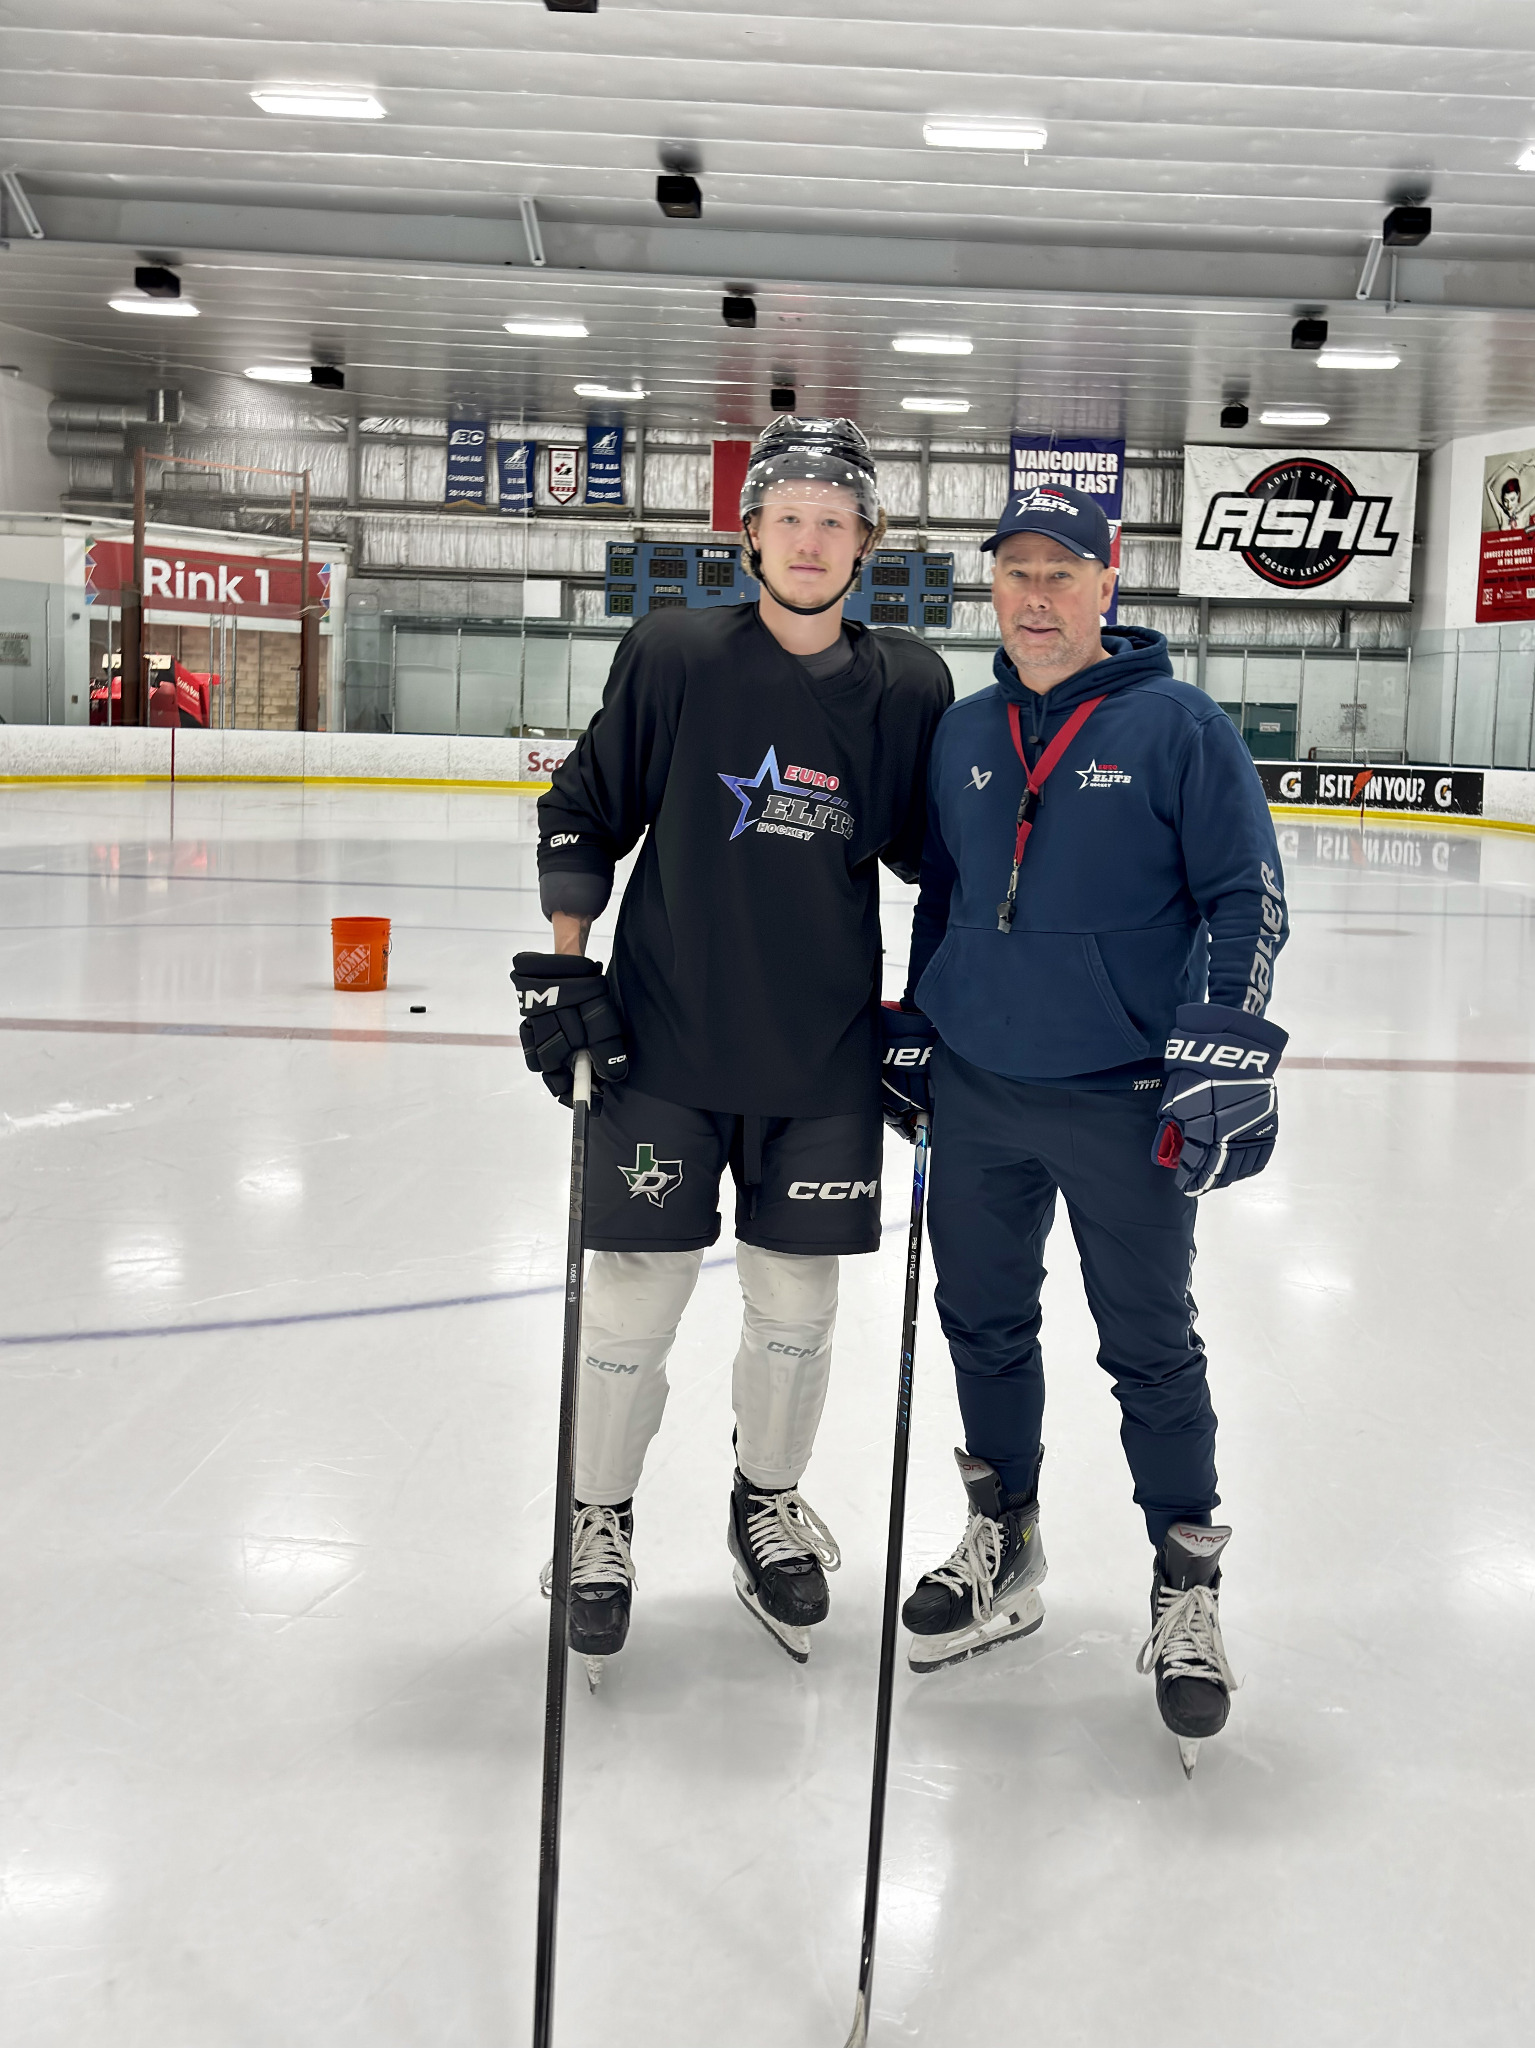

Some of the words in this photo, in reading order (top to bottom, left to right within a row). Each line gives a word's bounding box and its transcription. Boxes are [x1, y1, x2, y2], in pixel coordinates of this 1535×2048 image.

[449, 429, 485, 445] BC
[787, 445, 833, 453] BAUER
[1014, 449, 1119, 473] VANCOUVER
[1013, 471, 1072, 490] NORTH
[1075, 473, 1118, 494] EAST
[1266, 470, 1302, 490] ADULT
[1309, 471, 1338, 492] SAFE
[1030, 497, 1079, 516] ELITE
[1199, 494, 1397, 554] ASHL
[1259, 552, 1295, 576] HOCKEY
[1300, 555, 1336, 577] LEAGUE
[143, 557, 244, 604] Rink
[254, 568, 270, 606] 1
[784, 765, 840, 791] EURO
[1091, 774, 1132, 784] ELITE
[1280, 771, 1301, 799] G
[1319, 774, 1335, 798] IS
[1337, 774, 1353, 798] IT
[1364, 775, 1382, 801] IN
[1383, 776, 1426, 803] YOU?
[1434, 777, 1452, 808] G
[761, 794, 855, 841] ELITE
[550, 833, 579, 848] GW
[756, 822, 815, 841] HOCKEY
[1243, 861, 1283, 1017] BAUER
[1165, 1039, 1270, 1074] AUER
[787, 1180, 878, 1200] CCM
[767, 1341, 820, 1358] CCM
[586, 1356, 639, 1375] CCM
